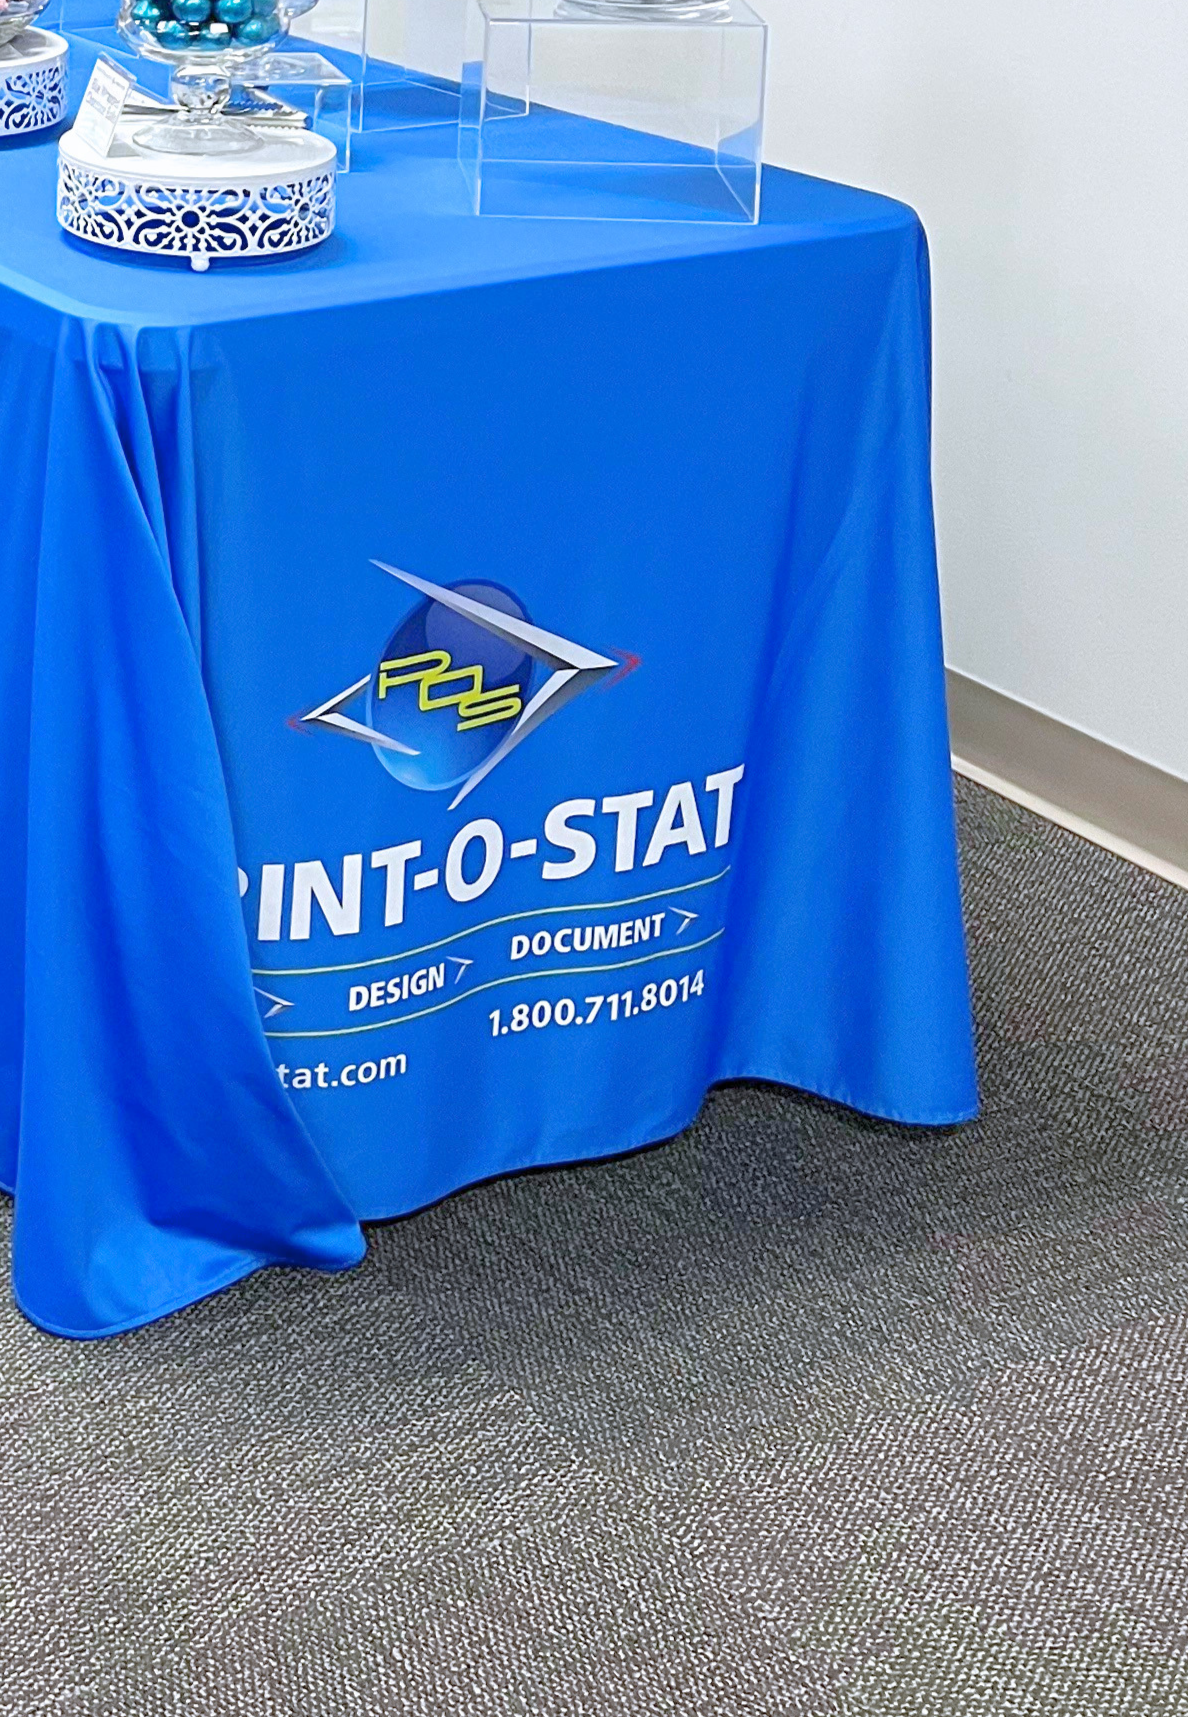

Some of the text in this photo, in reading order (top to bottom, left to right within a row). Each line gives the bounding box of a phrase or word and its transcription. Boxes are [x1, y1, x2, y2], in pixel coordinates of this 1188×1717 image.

[378, 649, 523, 732] POS
[237, 763, 745, 941] INT-O-STAT
[347, 911, 666, 1012] DESIGN DOCUMENT
[488, 968, 705, 1038] 1.800.711.8014
[275, 1053, 408, 1090] tat.com
